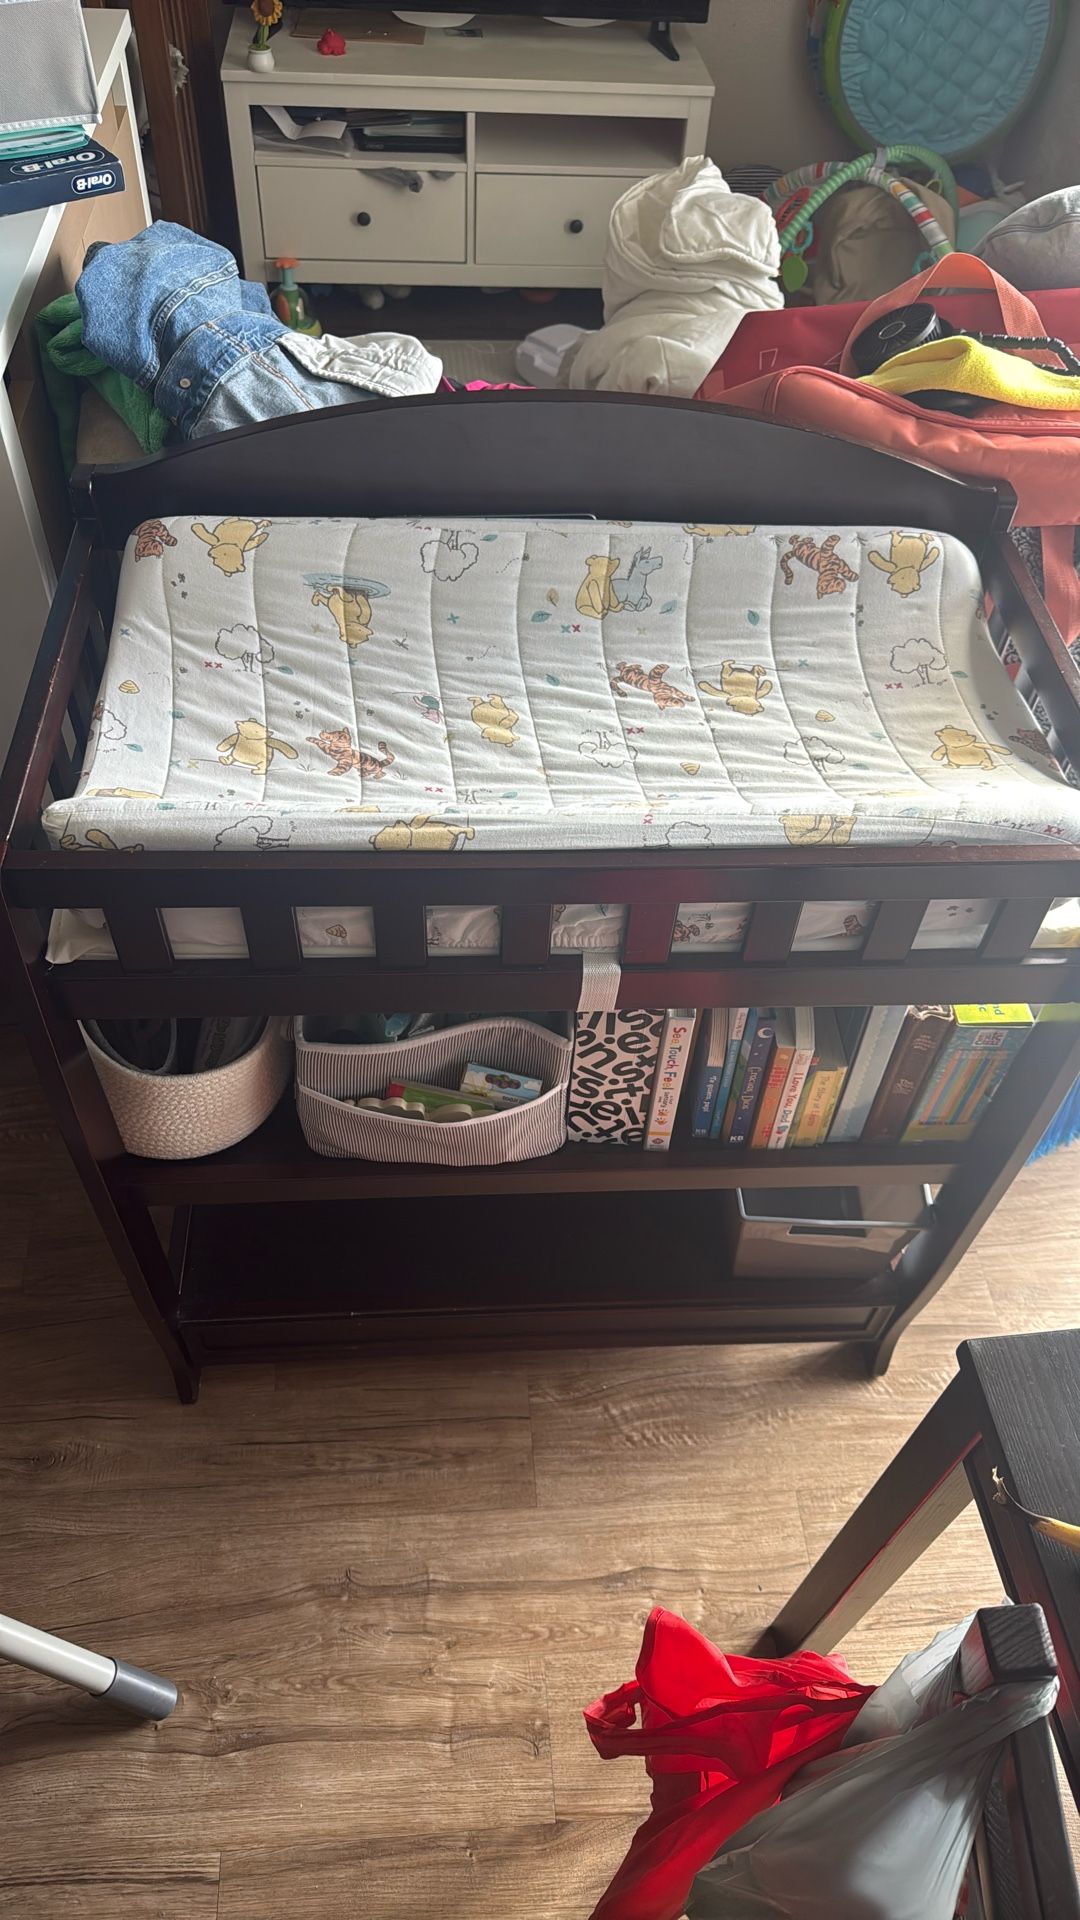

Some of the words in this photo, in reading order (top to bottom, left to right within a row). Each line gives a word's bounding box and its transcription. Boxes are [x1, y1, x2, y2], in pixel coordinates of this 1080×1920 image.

[21, 151, 96, 173] Oral-B
[76, 174, 113, 190] Oral-B
[661, 1071, 677, 1090] Feel
[789, 1076, 803, 1093] Love
[741, 1095, 754, 1110] Dios
[784, 1093, 798, 1109] You,
[780, 1109, 792, 1123] Dad
[729, 1135, 745, 1143] KB
